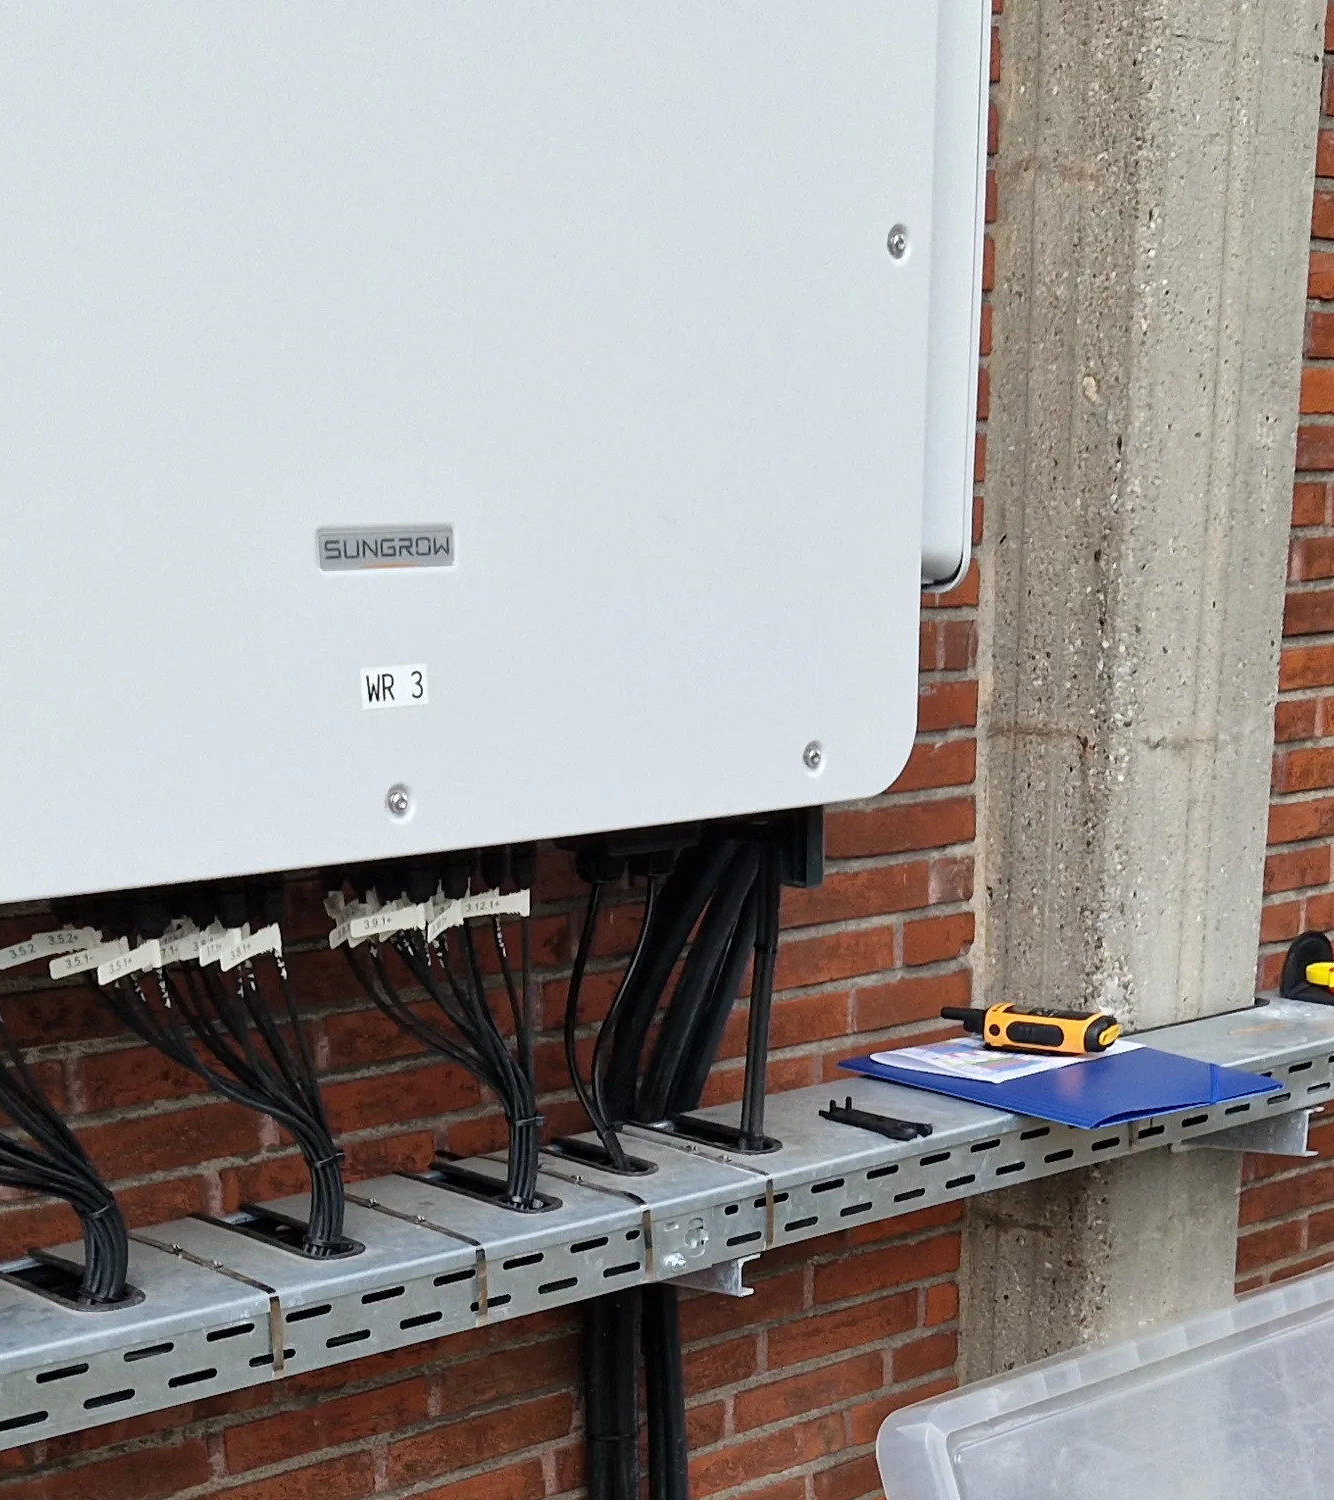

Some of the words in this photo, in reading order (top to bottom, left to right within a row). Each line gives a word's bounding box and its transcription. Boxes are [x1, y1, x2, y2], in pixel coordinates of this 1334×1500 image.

[323, 535, 451, 562] SUNGROW
[365, 673, 396, 703] WR
[410, 669, 425, 699] 3
